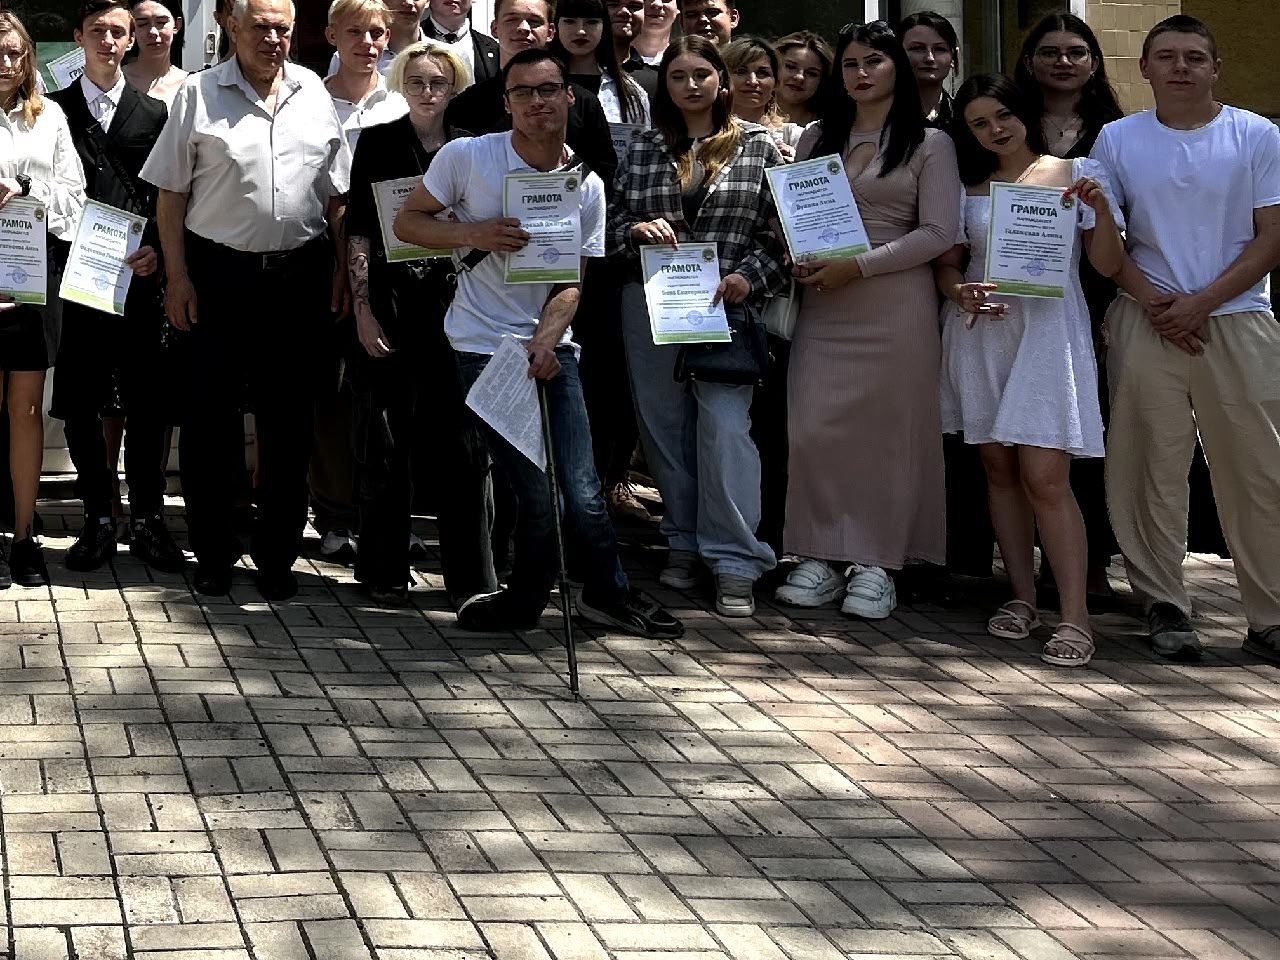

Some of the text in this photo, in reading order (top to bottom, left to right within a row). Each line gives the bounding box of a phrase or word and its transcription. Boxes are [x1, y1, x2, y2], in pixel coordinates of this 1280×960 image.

[788, 176, 831, 191] ГРАМОТА
[521, 193, 563, 204] ГРАМОТА
[1010, 203, 1058, 218] ГРАМОТА
[92, 222, 127, 241] ГРАМОТА
[661, 263, 703, 273] ГРАМОТА
